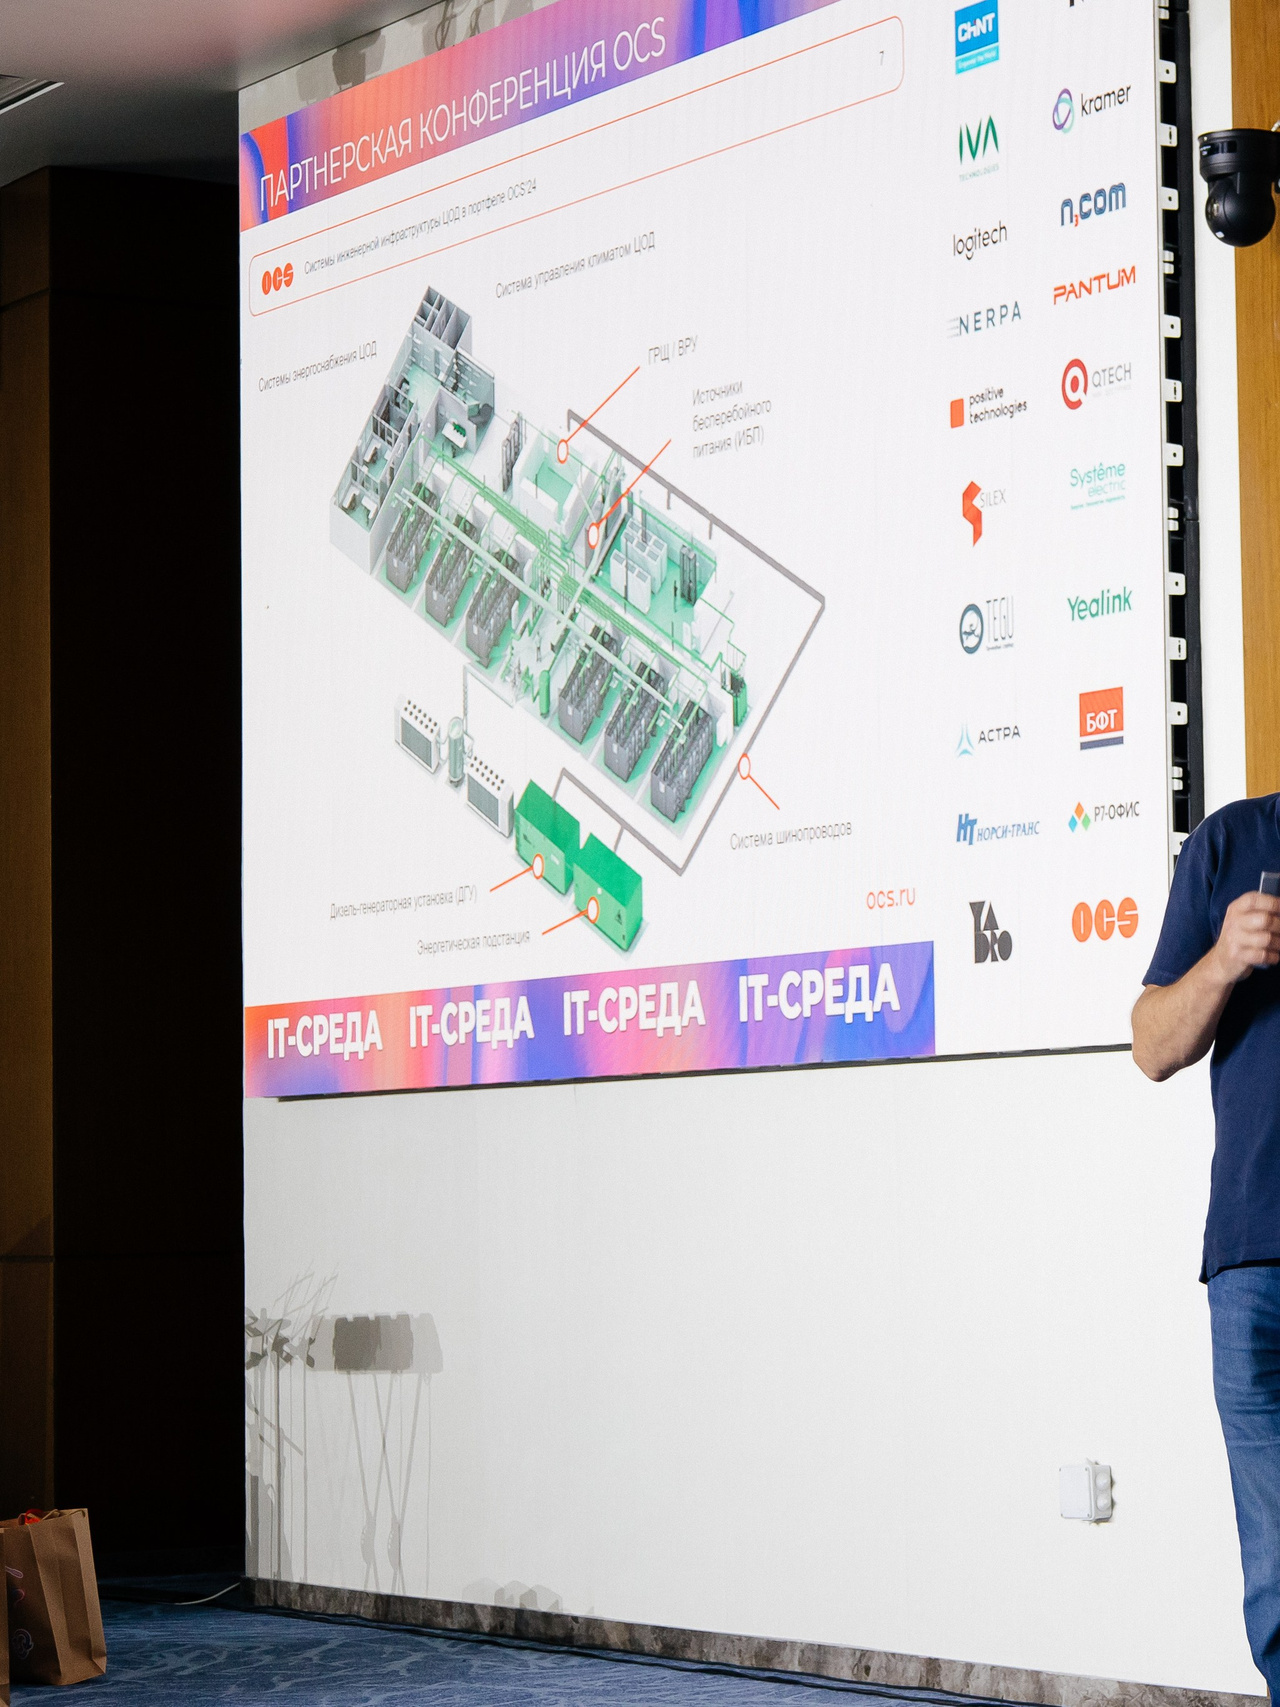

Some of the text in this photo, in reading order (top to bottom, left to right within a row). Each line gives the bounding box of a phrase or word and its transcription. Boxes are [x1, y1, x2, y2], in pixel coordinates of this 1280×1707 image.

[259, 16, 667, 211] ПАРТНЕРСКАЯ КОНФЕРЕНЦИЯ OCS
[1080, 85, 1132, 117] kramer
[958, 115, 999, 165] IVA
[304, 253, 335, 275] Системы
[336, 238, 380, 263] инженерной
[380, 216, 441, 249] инфраструктуры
[442, 202, 462, 226] ЦОД
[468, 193, 505, 218] портфеле
[953, 220, 1008, 261] logitech
[261, 262, 294, 296] OCS
[495, 231, 656, 298] Система управления климатом ЦОД
[1053, 265, 1137, 305] PANTUM
[959, 301, 1022, 336] NERPA
[258, 340, 378, 392] Системы энергоснабжения ЦОД
[648, 343, 671, 365] ГРЩ
[678, 335, 698, 357] ВРУ
[1092, 362, 1132, 388] QTECH
[692, 380, 743, 406] Источники
[969, 387, 1004, 408] positive
[692, 400, 772, 432] бесперебойного
[969, 400, 1028, 424] technologies
[693, 425, 765, 459] питания (ИБП)
[1088, 480, 1126, 497] electric
[986, 596, 1014, 643] TEGU
[1067, 586, 1133, 621] Yealink
[978, 725, 1021, 744] АСТРА
[1086, 709, 1118, 733] БФТ
[1094, 801, 1140, 822] Р7-ОФИС
[730, 822, 852, 850] Система шинопроводов
[977, 821, 1040, 842] НОРСИ-ТРАНС
[330, 884, 477, 920] Дизель-генераторная установка (ДГУ)
[866, 887, 916, 910] ocs.ru
[1071, 897, 1139, 943] OCS
[417, 929, 530, 957] Энергетическая подстанция
[267, 962, 901, 1061] IT-СРЕДА IT-СРЕДА IT-СРЕДА IT-СРЕДА
